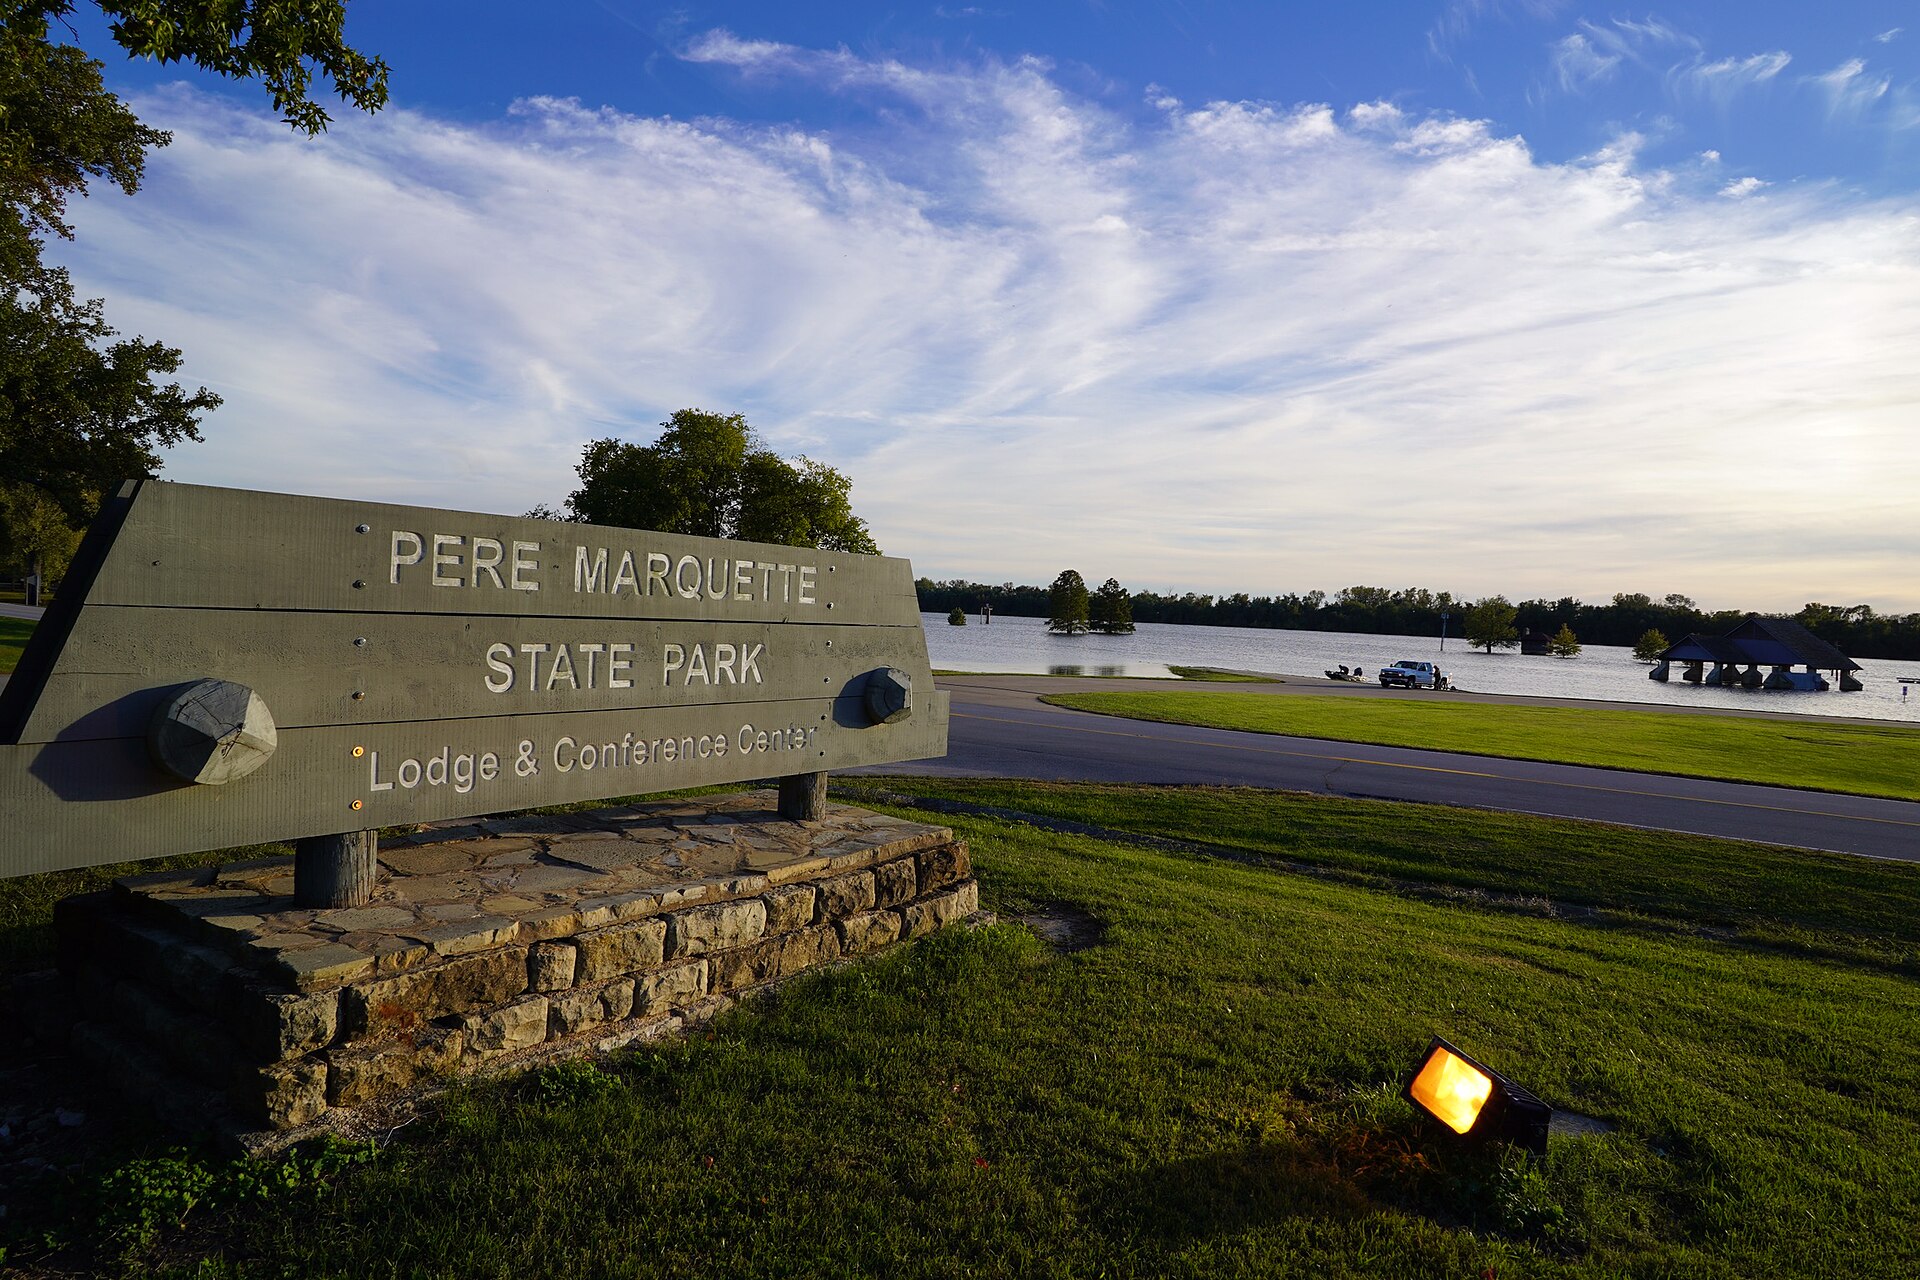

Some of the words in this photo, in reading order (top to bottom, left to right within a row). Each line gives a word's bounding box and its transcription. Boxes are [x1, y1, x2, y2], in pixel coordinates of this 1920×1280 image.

[389, 530, 542, 591] PERE
[574, 545, 818, 605] MARQUETTE
[484, 642, 635, 693] STATE
[663, 643, 765, 686] PARK
[370, 746, 500, 793] Lodge
[515, 739, 541, 777] &
[553, 731, 728, 773] Conference
[738, 724, 818, 756] Center
